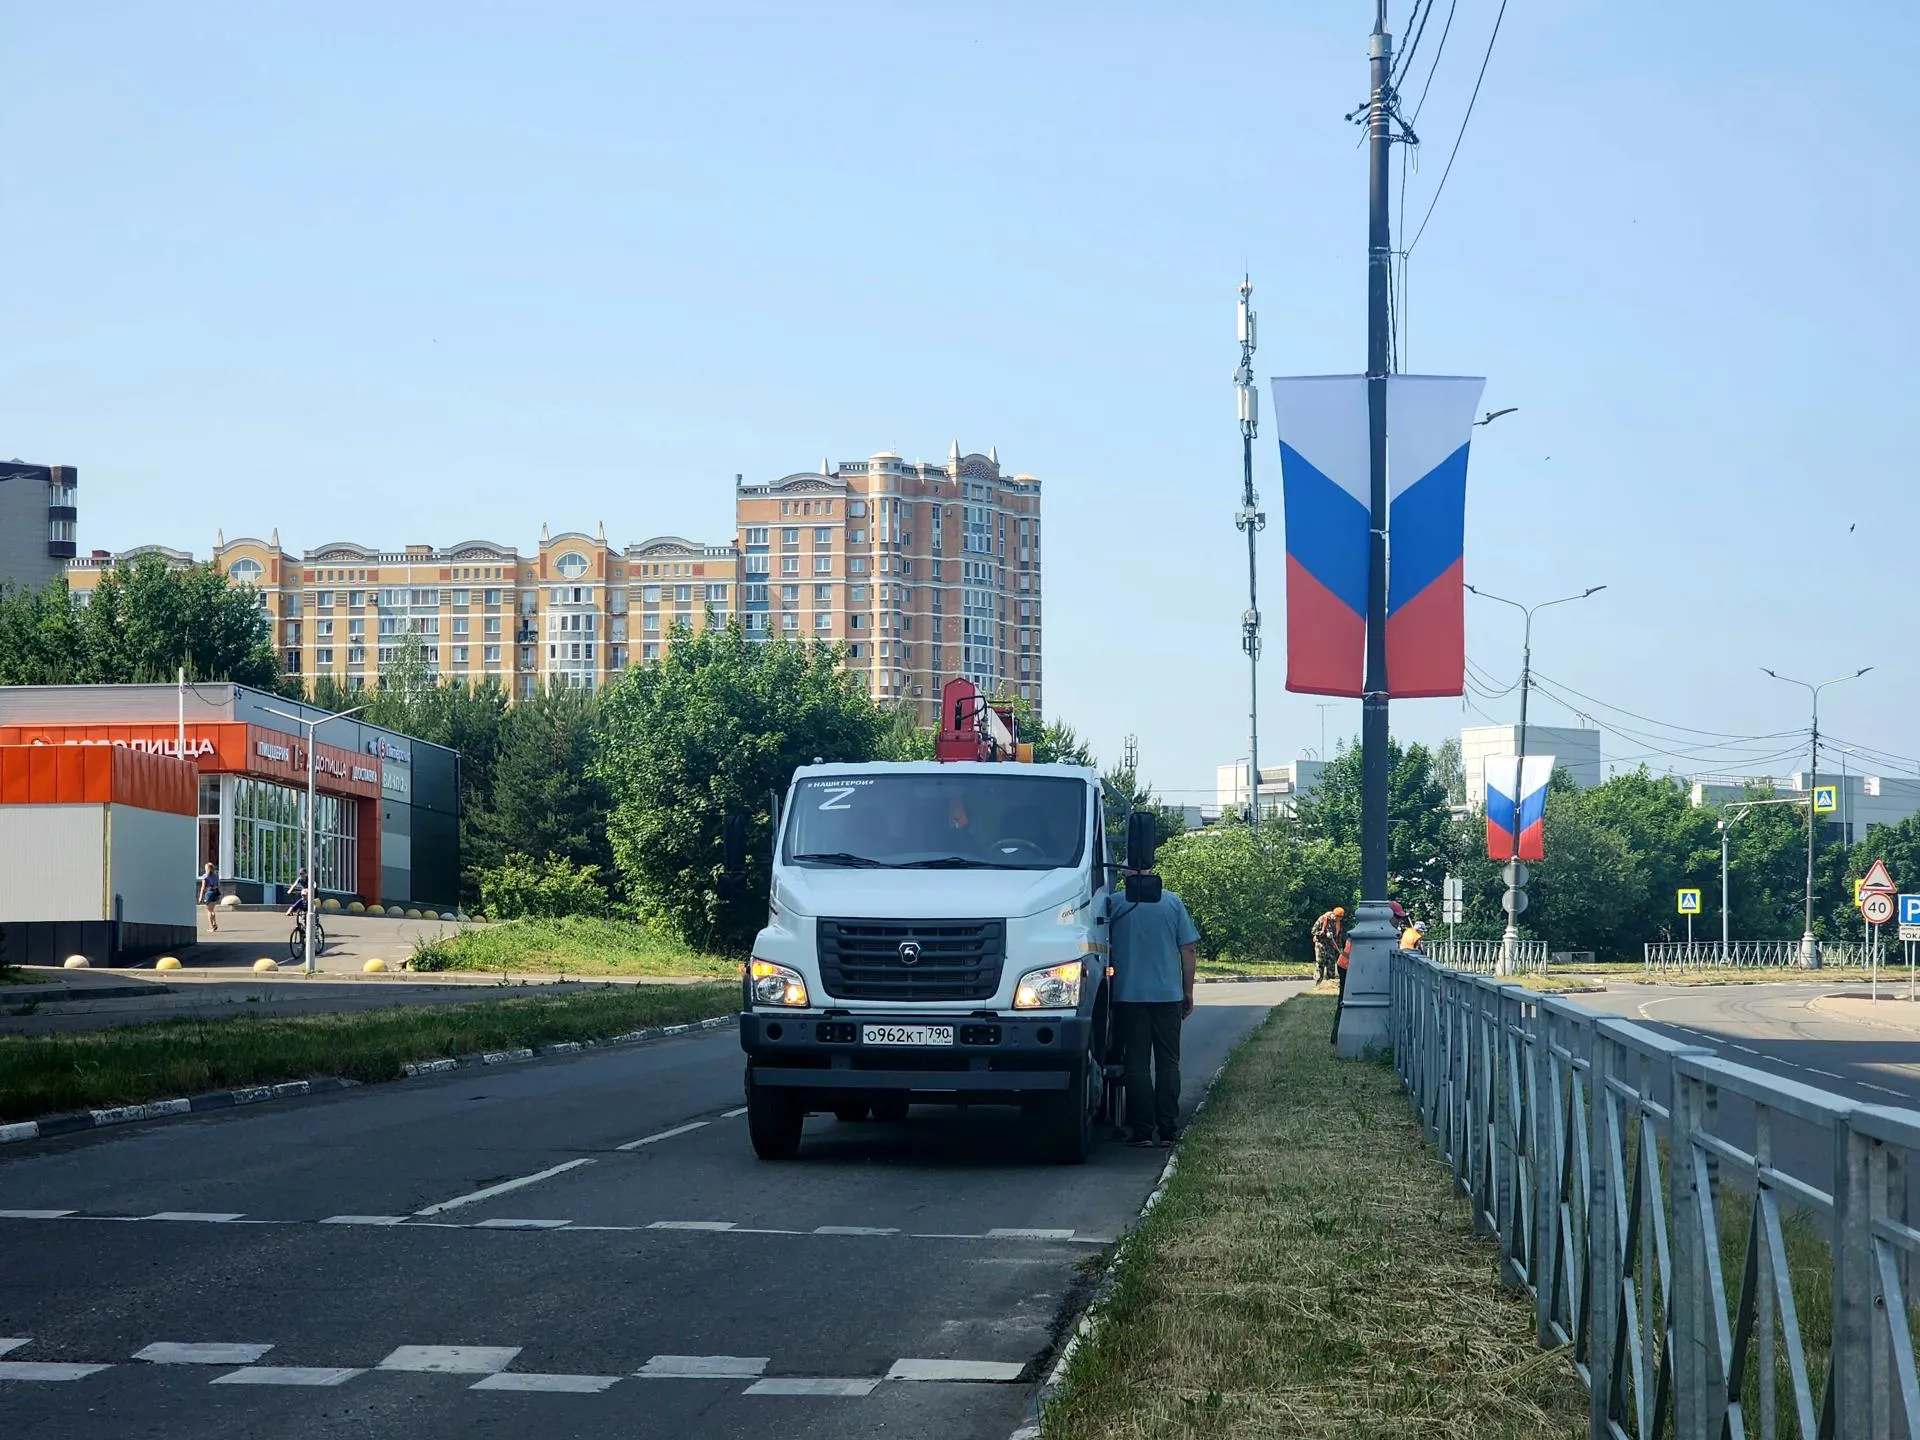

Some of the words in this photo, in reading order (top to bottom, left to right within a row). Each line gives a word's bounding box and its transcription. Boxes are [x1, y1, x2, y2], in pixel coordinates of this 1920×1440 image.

[259, 741, 289, 762] ПИЦЦЕРИЯ
[818, 787, 856, 810] Z
[1867, 902, 1886, 914] 40
[867, 1027, 924, 1043] О962КТ
[927, 1027, 950, 1039] 790
